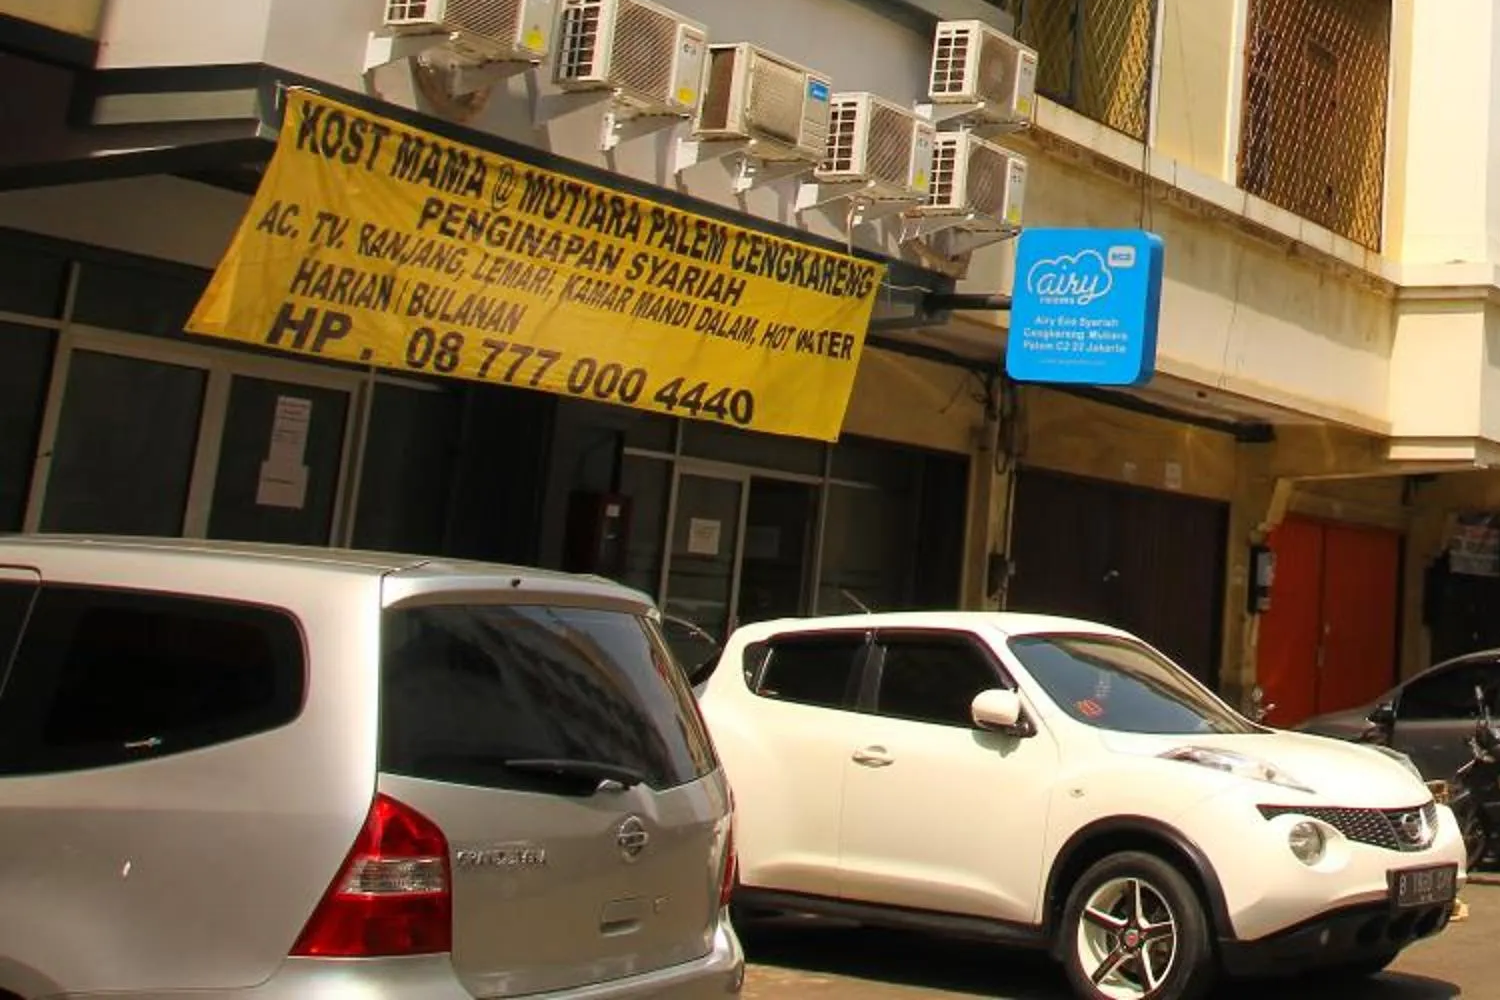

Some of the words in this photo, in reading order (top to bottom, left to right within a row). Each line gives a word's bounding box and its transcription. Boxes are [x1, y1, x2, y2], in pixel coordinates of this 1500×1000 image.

[296, 100, 390, 171] KOST
[390, 133, 487, 199] MAMA
[492, 163, 517, 212] @
[517, 170, 641, 243] MUTIARA
[645, 207, 727, 265] PALEM
[725, 231, 876, 299] CENGKARENG
[289, 257, 397, 313] HARIAN
[405, 281, 528, 334] BULANAN
[416, 197, 625, 275] PENGINAPAN
[625, 251, 747, 307] SYARIAH
[1037, 264, 1099, 305] airy
[558, 271, 634, 313] KAMAR
[631, 286, 696, 329] MANDI
[759, 322, 796, 349] HOT
[406, 326, 465, 372] 08
[477, 337, 562, 386] 777
[567, 357, 648, 404] 000
[655, 377, 754, 425] 4440
